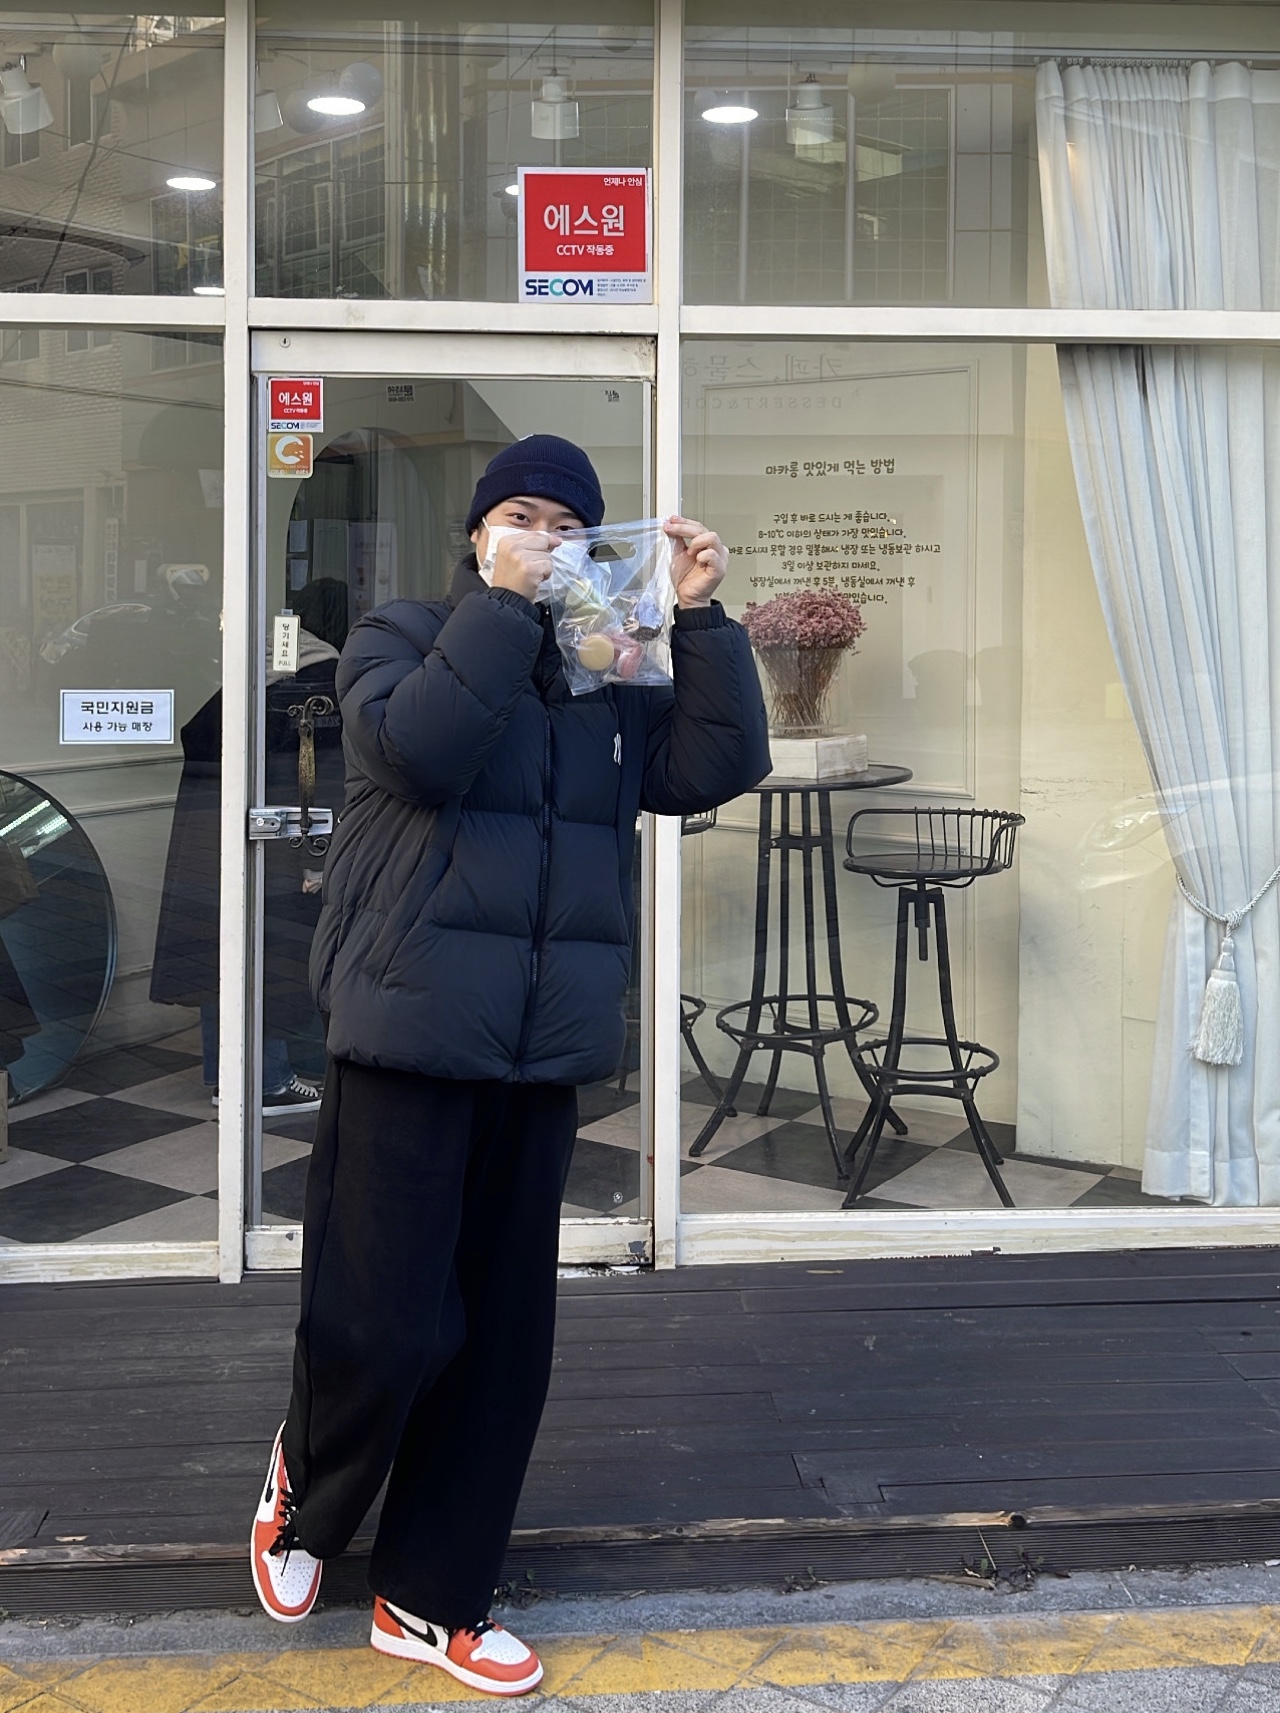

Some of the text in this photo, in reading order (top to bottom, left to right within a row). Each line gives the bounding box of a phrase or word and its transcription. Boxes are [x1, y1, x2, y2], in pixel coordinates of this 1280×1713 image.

[603, 177, 643, 187] 언제나 안심
[543, 204, 625, 237] 에스원
[556, 244, 615, 256] CCTV 작동중
[525, 278, 594, 297] SECOM
[278, 391, 313, 406] 에스원
[270, 422, 300, 430] SECOM
[765, 458, 895, 478] 마카롱 맛있게 먹는 방법
[790, 513, 798, 524] 후
[800, 513, 816, 523] 바로
[818, 512, 841, 523] 드시는
[843, 513, 853, 521] 게
[855, 510, 890, 524] 좋습니다.
[786, 530, 811, 538] 이하의
[813, 529, 839, 540] 상태가
[841, 528, 859, 539] 가장
[861, 527, 906, 539] 맛있습니다.
[745, 546, 768, 555] 드시지
[770, 544, 787, 556] 못할
[788, 545, 803, 556] 경우
[841, 544, 859, 555] 냉장
[861, 544, 876, 555] 또는
[879, 543, 912, 556] 냉동보관
[915, 544, 941, 553] 하시고
[781, 560, 880, 572] 3일 이상 보관하지 마세요.
[749, 575, 791, 588] 냉장실에서
[793, 576, 811, 587] 꺼낸
[813, 576, 821, 587] 후
[841, 575, 883, 588] 냉동실에서
[886, 576, 905, 588] 꺼낸
[908, 576, 916, 588] 후
[281, 623, 290, 657] 당기세요
[81, 700, 154, 715] 국민지원금
[82, 721, 153, 732] 사용 가능 매장
